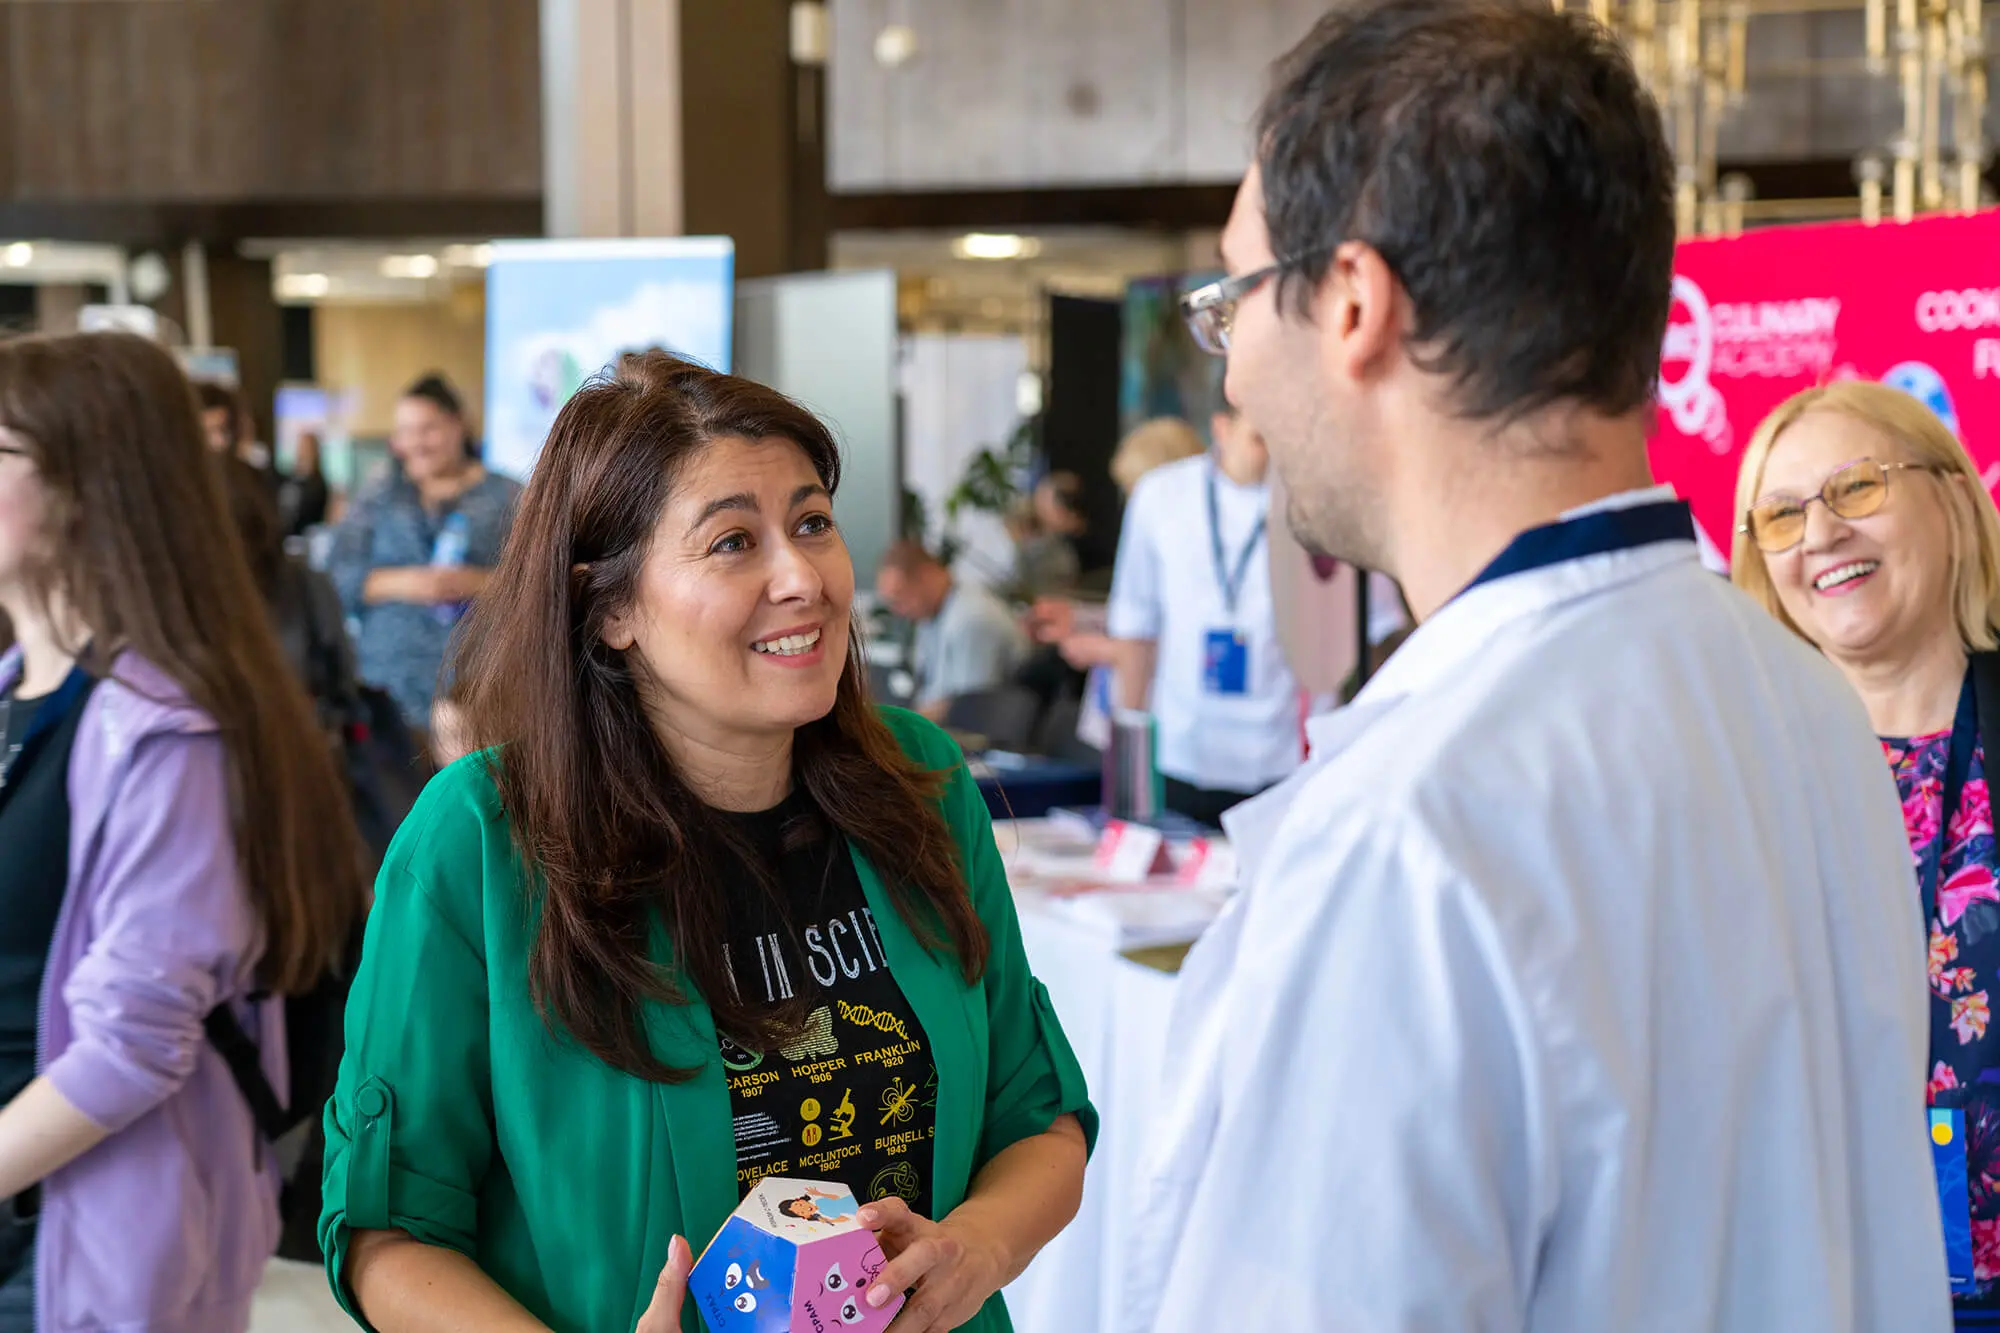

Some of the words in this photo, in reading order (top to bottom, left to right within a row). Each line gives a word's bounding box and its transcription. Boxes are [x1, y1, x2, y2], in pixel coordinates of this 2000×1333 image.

[741, 1085, 763, 1098] 1907
[810, 1071, 832, 1084] 1906
[882, 1055, 904, 1068] 1920
[791, 1058, 847, 1078] HOPPER
[854, 1039, 921, 1065] FRANKLIN
[799, 1143, 862, 1168] MCCLINTOCK
[875, 1129, 925, 1150] BURNELL
[819, 1159, 841, 1173] 1902
[886, 1143, 907, 1156] 1943
